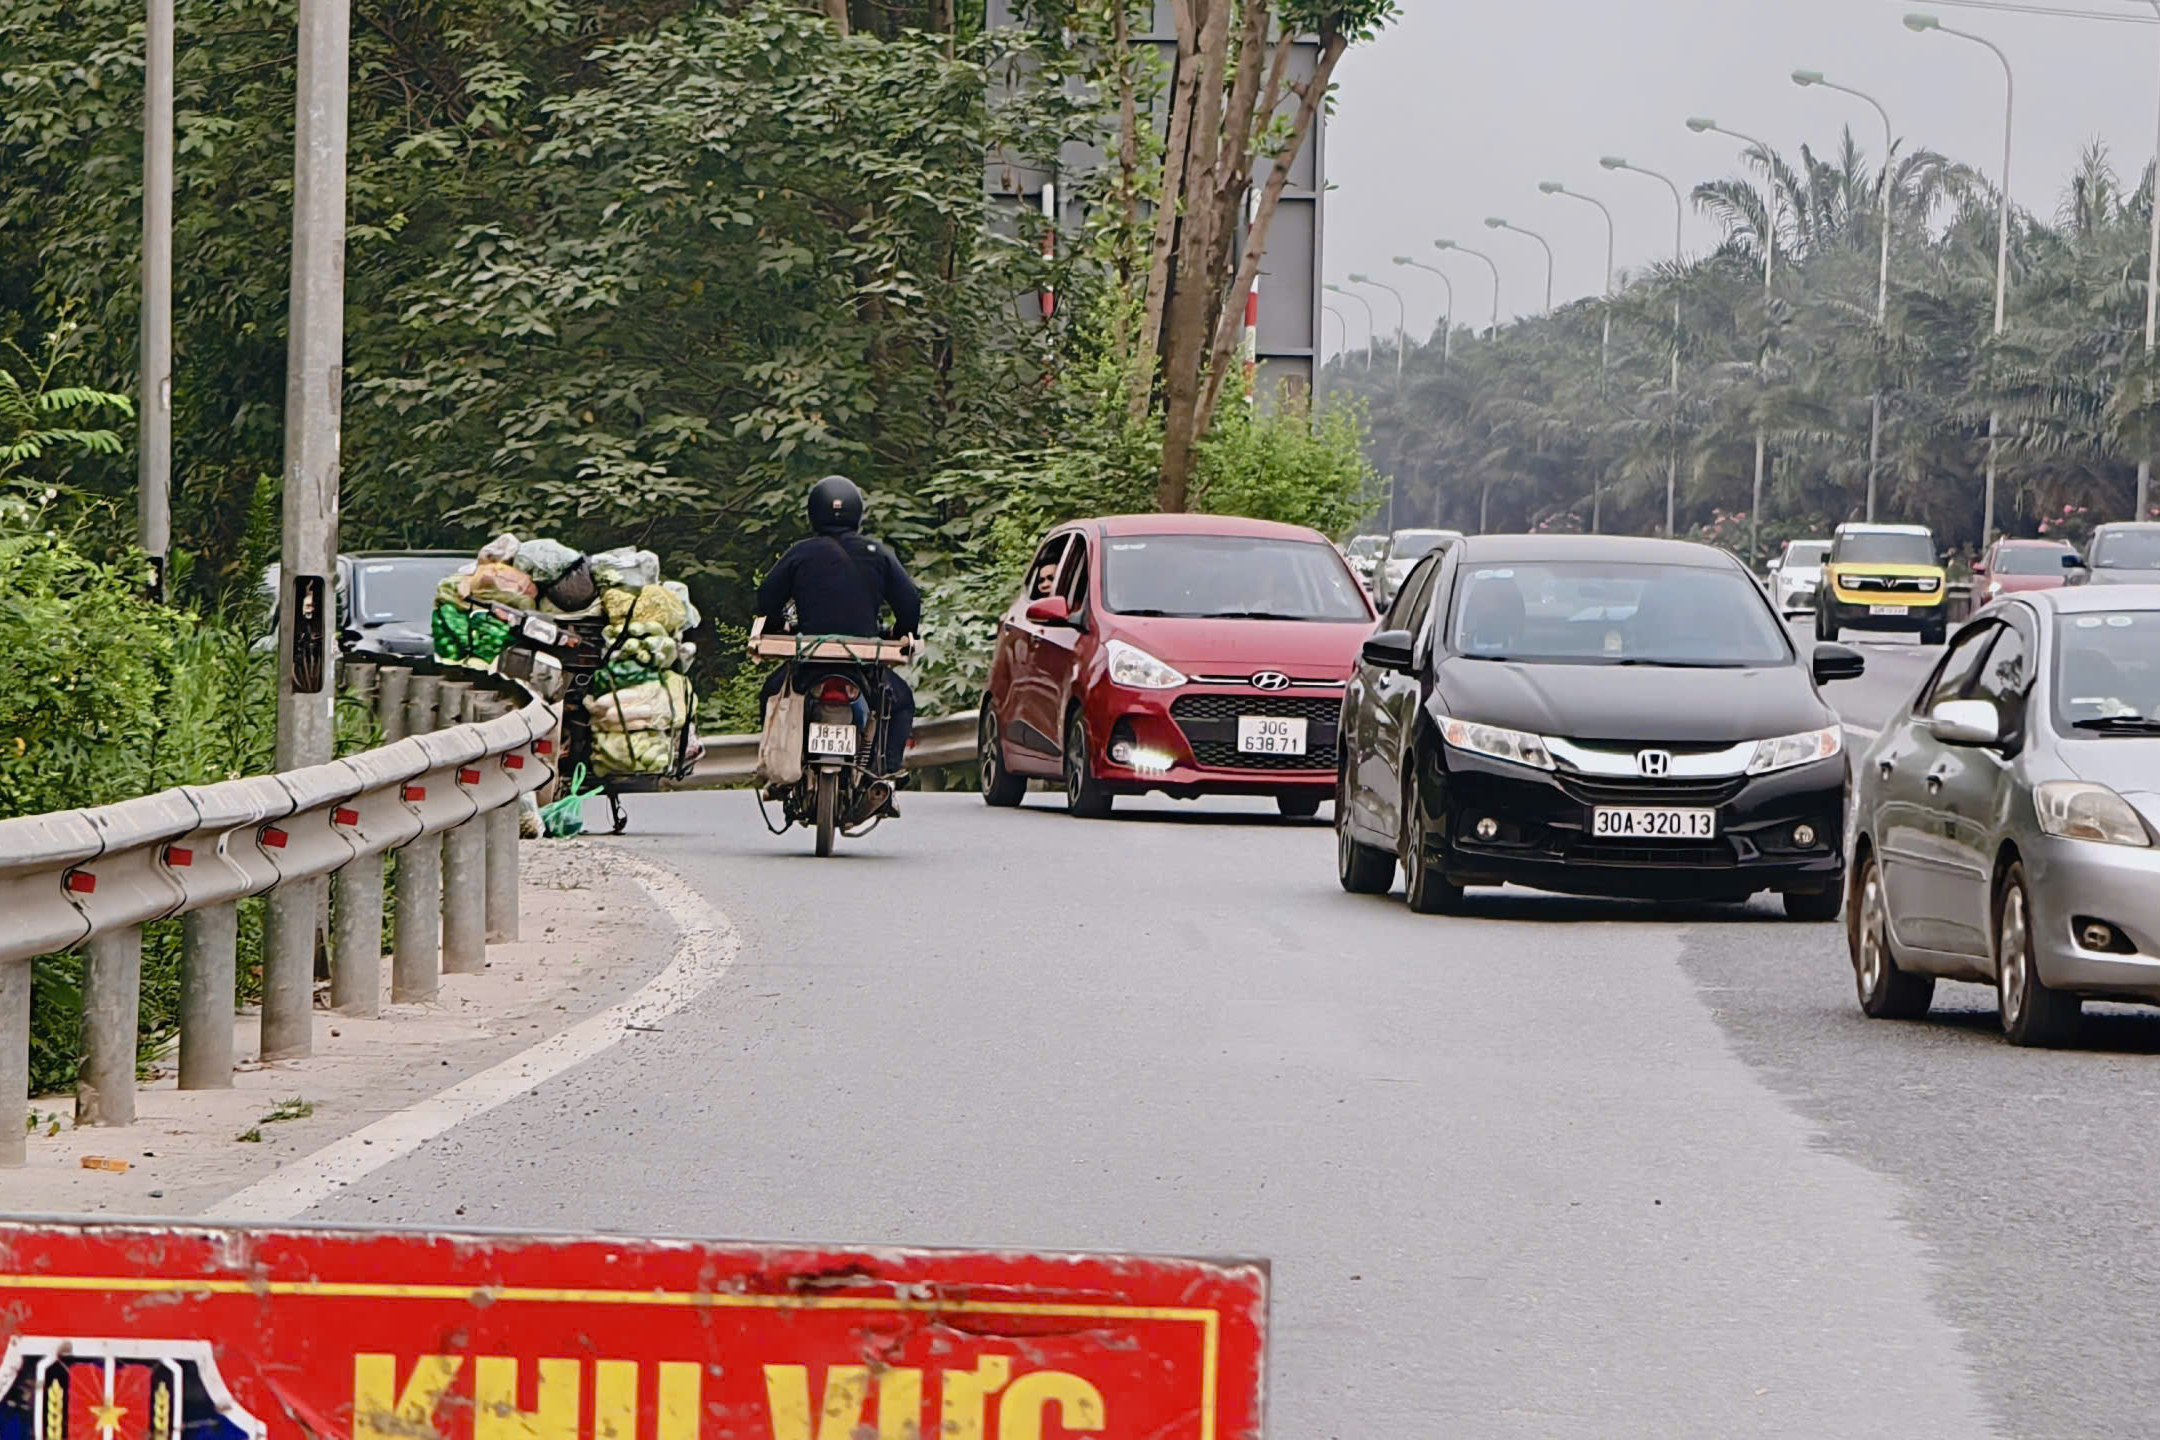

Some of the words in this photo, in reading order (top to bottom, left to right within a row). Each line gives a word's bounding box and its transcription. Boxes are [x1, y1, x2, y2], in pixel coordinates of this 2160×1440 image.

[1258, 720, 1288, 735] 30G
[1245, 736, 1297, 752] 638.71
[1597, 812, 1711, 835] 30A-320.13
